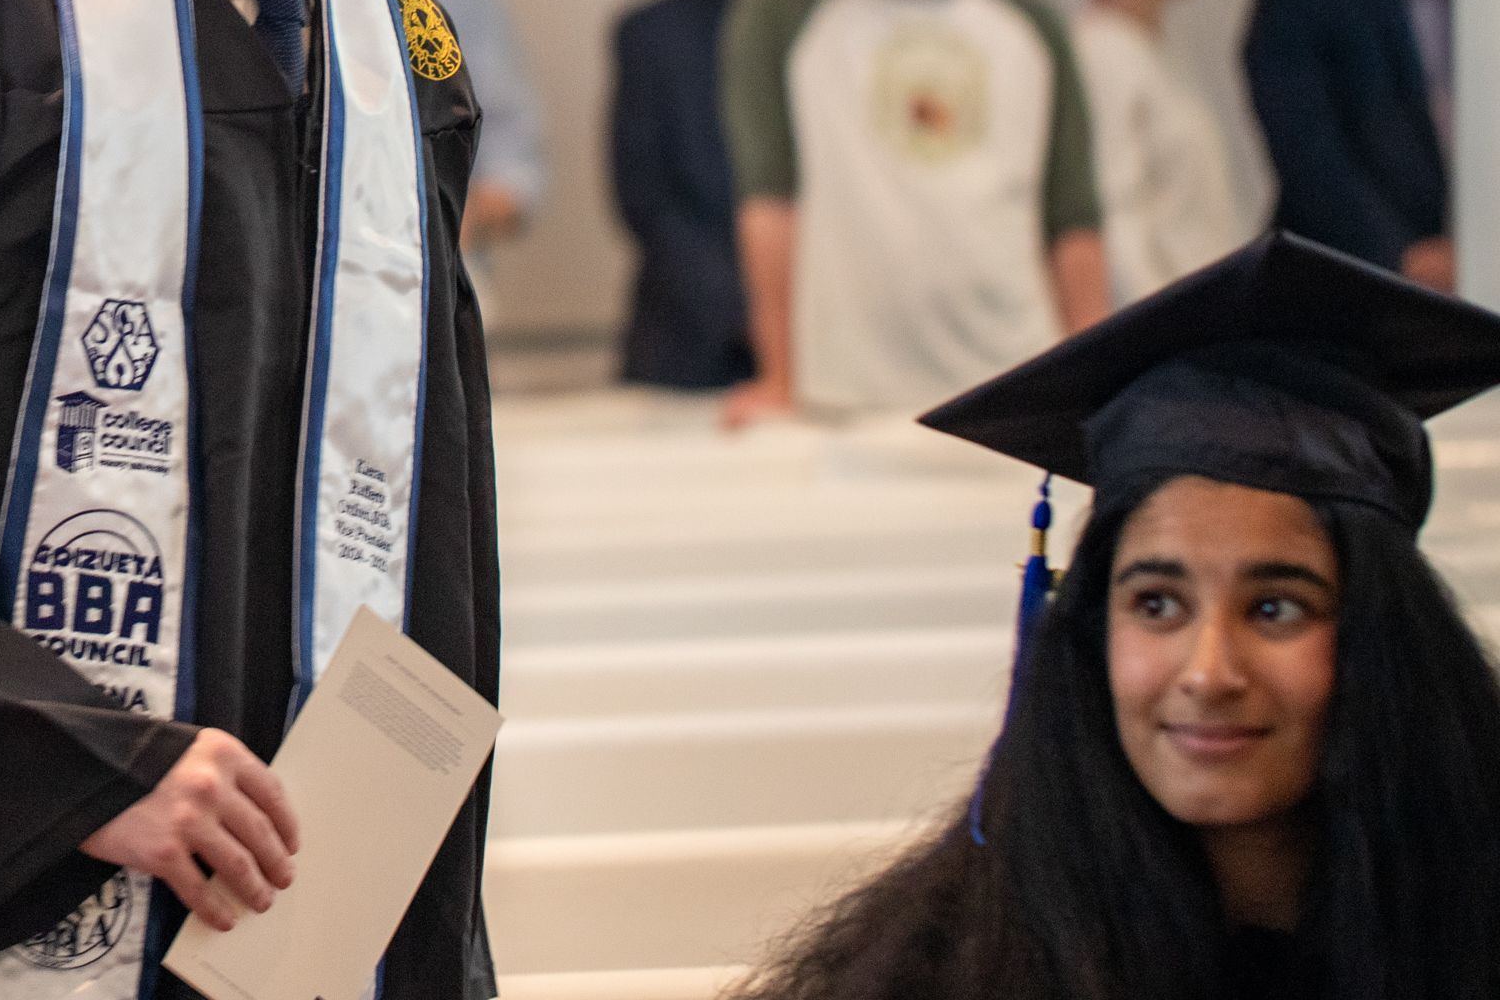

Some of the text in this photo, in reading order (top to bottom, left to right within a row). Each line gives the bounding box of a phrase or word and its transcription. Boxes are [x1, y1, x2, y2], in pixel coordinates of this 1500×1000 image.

[103, 411, 172, 438] college
[101, 433, 170, 455] council
[34, 545, 162, 578] GOIZUETA
[26, 571, 163, 644] BBA
